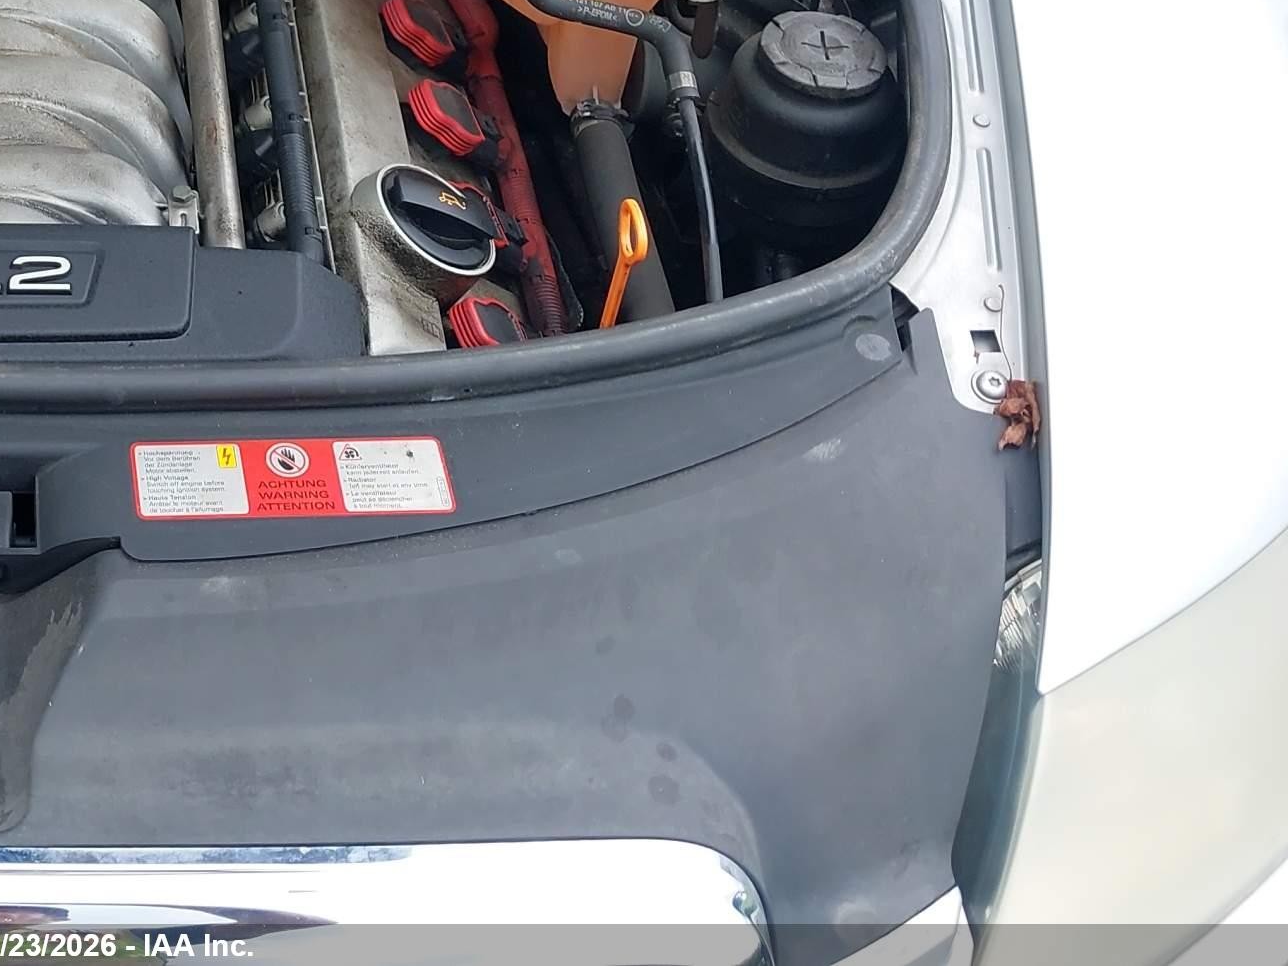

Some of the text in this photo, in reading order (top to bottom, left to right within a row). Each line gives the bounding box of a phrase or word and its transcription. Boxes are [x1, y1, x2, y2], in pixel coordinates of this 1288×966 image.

[258, 479, 328, 489] ACHTUNG
[258, 490, 330, 500] WARNING
[257, 501, 336, 511] ATTENTION
